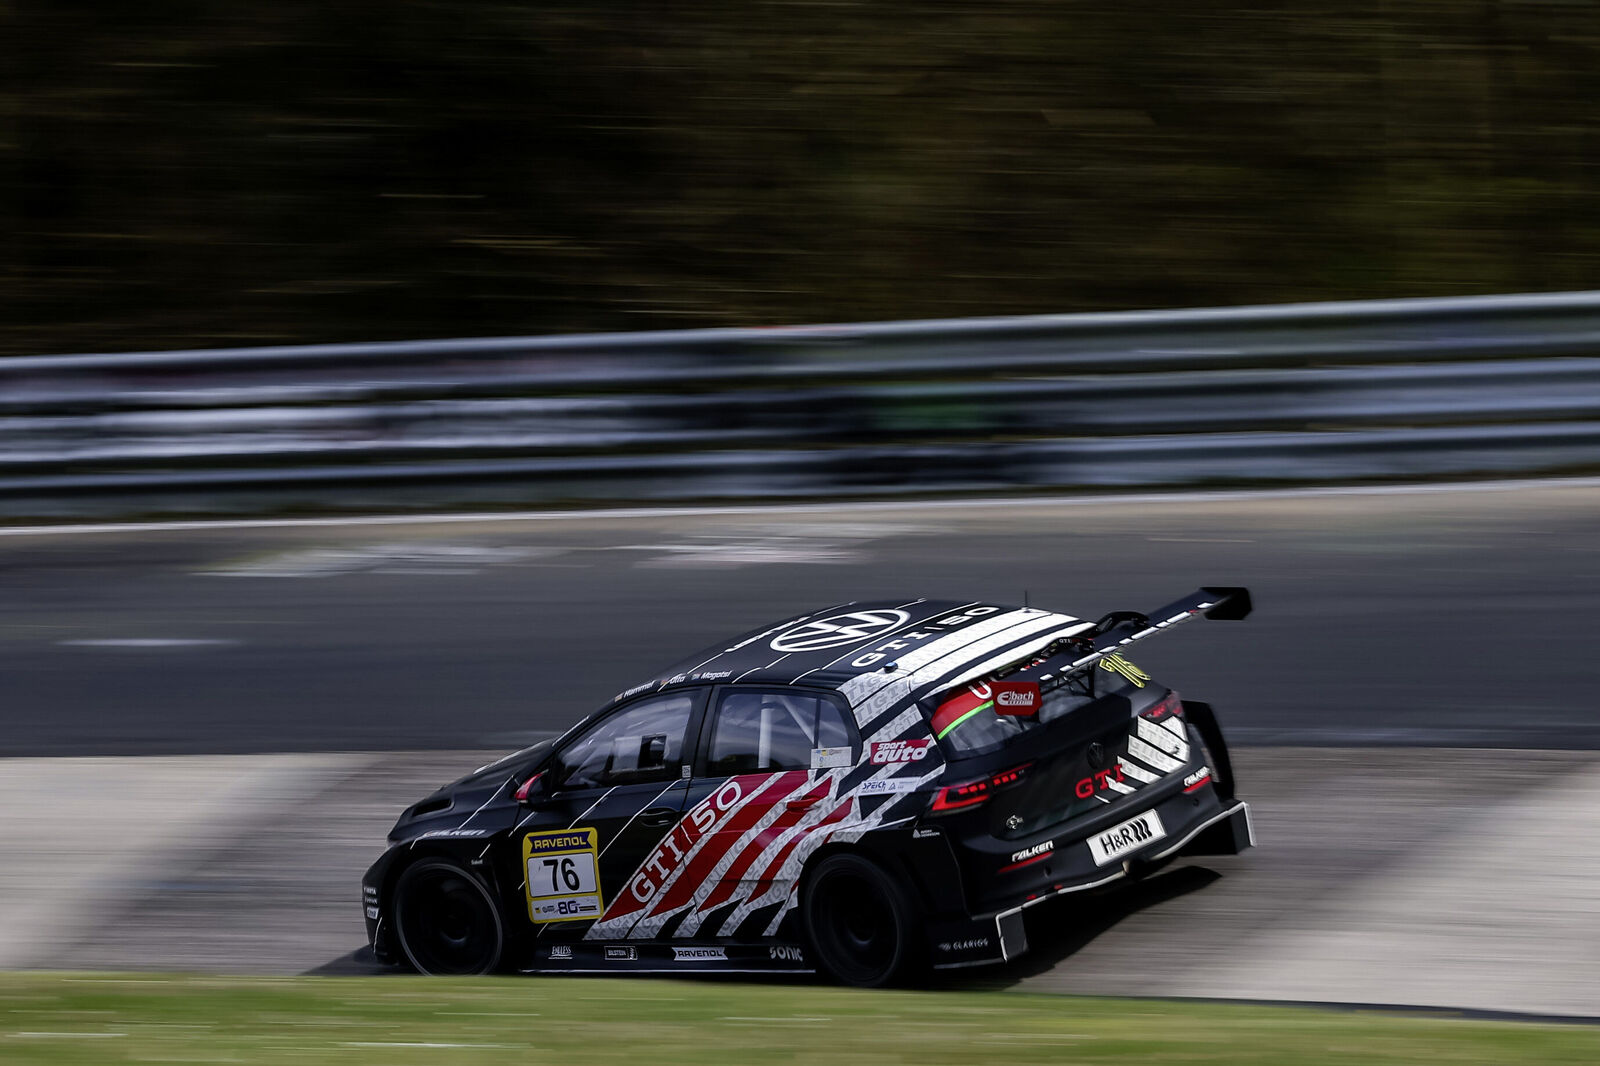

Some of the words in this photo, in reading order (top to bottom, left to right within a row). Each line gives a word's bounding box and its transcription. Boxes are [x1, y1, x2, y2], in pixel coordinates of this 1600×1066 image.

[997, 690, 1034, 706] Eibach
[873, 745, 928, 764] auto
[877, 740, 907, 751] sport
[1075, 765, 1126, 799] GTI
[1183, 765, 1210, 787] FALKEN
[533, 836, 587, 850] RAVENOL
[1011, 840, 1055, 863] FALKEN
[1100, 829, 1134, 856] H&R
[542, 858, 580, 892] 76
[677, 948, 723, 957] RAVENOL
[768, 946, 803, 961] SONIC
